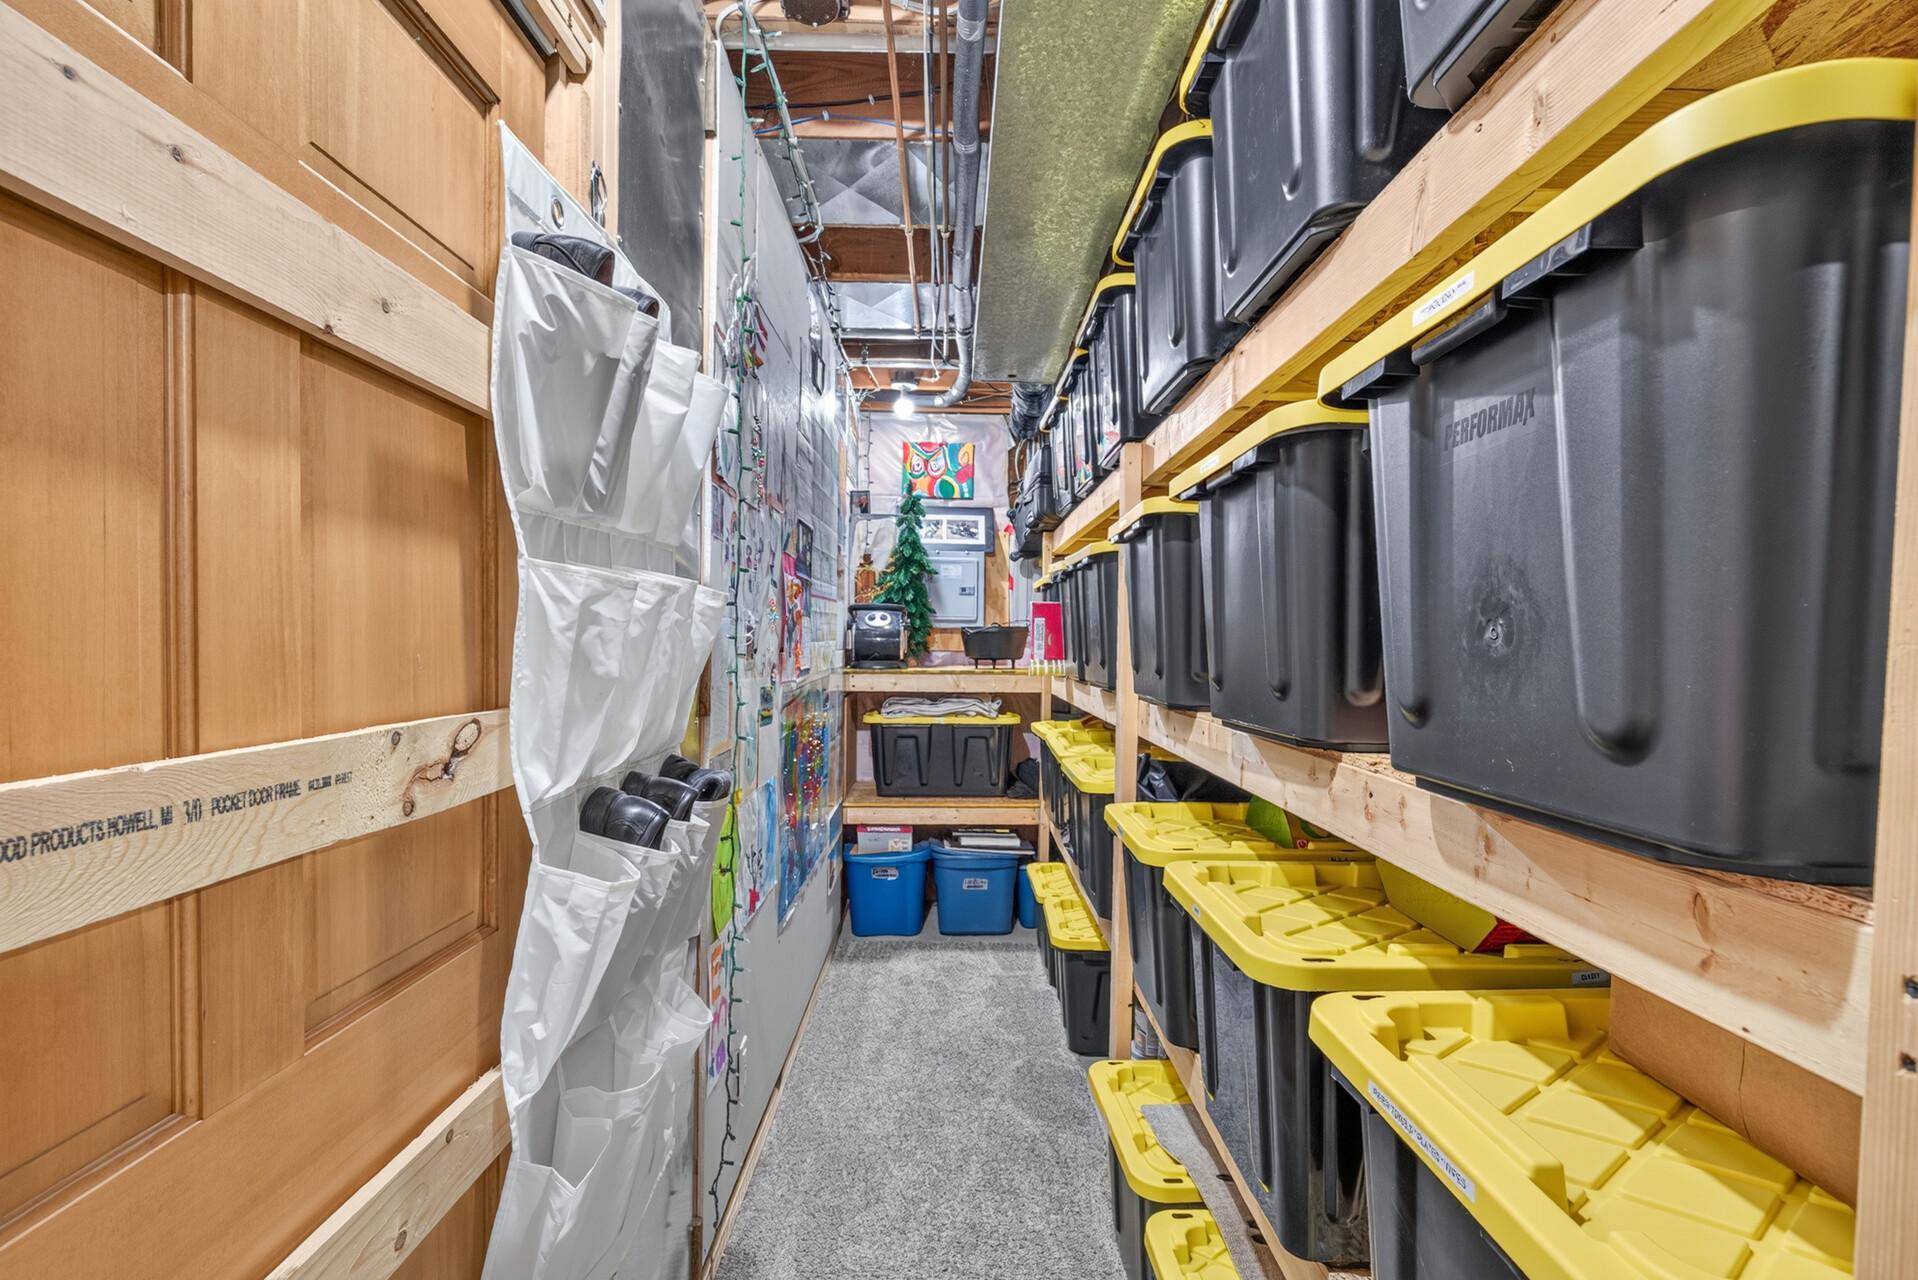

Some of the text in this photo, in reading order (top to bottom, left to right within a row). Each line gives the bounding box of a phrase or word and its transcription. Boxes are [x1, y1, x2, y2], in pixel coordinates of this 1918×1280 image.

[1444, 387, 1536, 451] PERFORMAX
[31, 819, 104, 856] PRODUCTS
[211, 791, 247, 817] POCKET
[248, 786, 273, 808] DOOR
